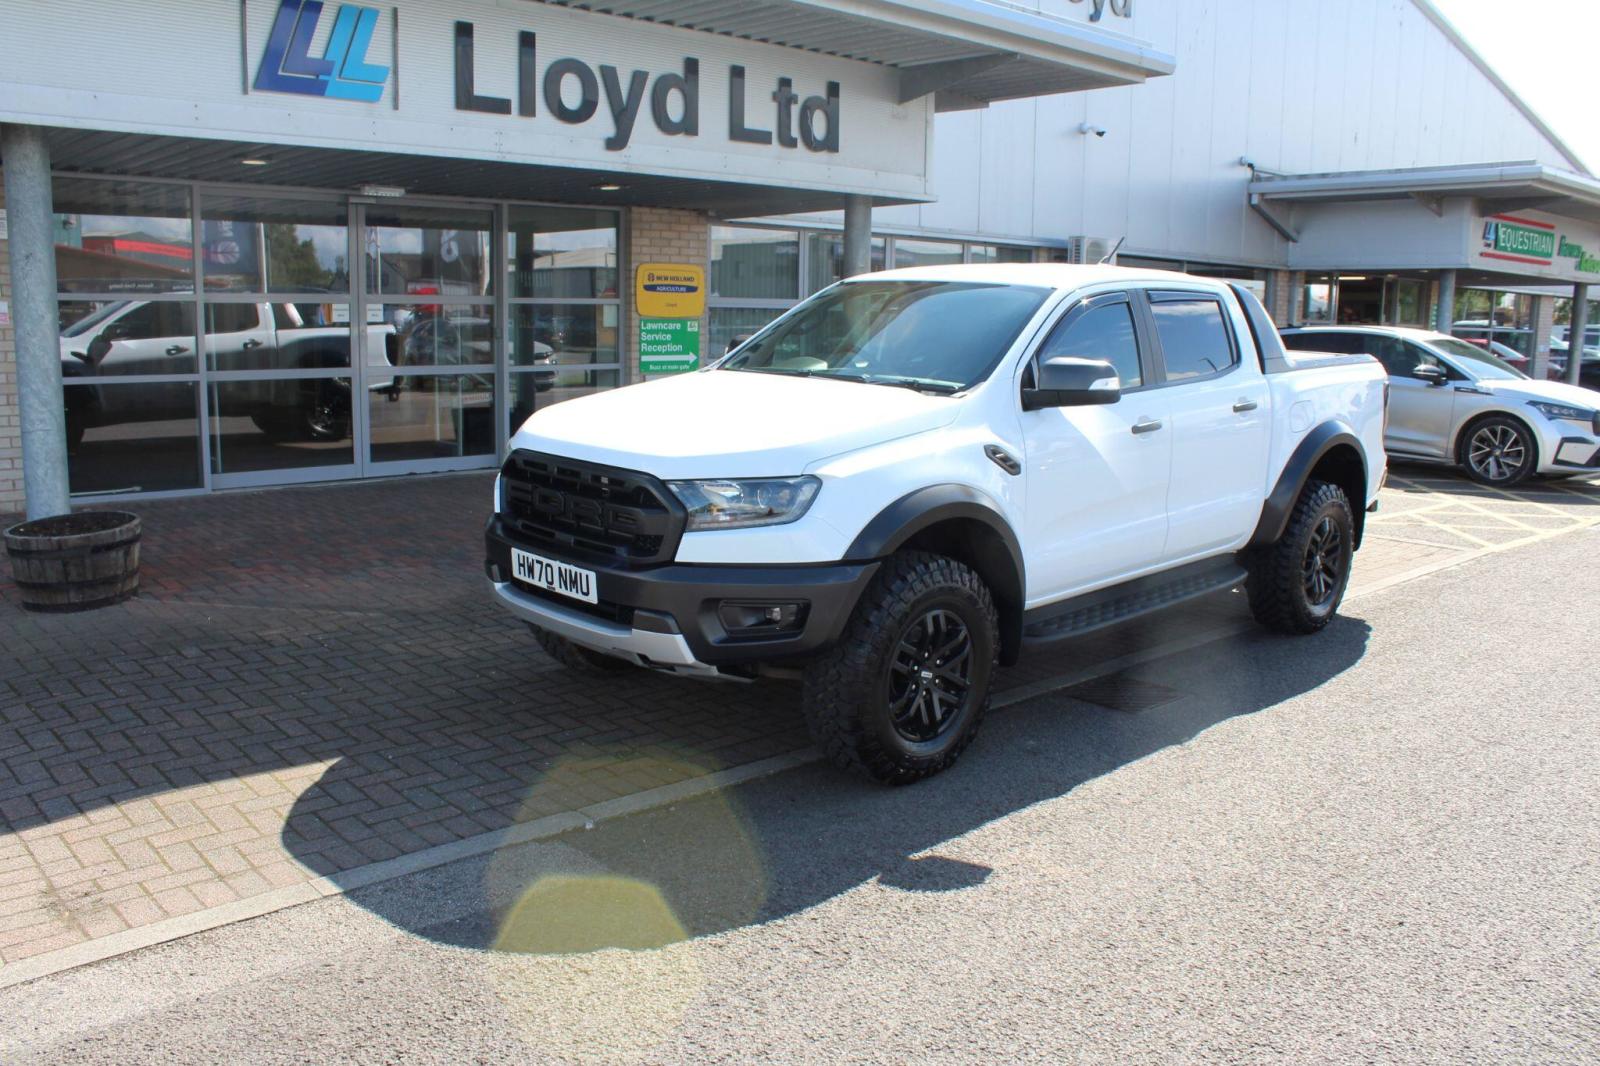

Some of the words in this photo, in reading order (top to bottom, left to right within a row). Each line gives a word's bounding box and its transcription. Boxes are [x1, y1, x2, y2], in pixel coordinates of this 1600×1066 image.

[455, 20, 699, 151] Lloyd
[728, 64, 841, 153] Ltd
[1499, 226, 1553, 253] EQUESTRIAN
[641, 320, 681, 330] Lawncare
[641, 332, 672, 341] Service
[641, 343, 683, 353] Reception
[517, 553, 555, 586] HW70
[558, 566, 590, 597] NMU
